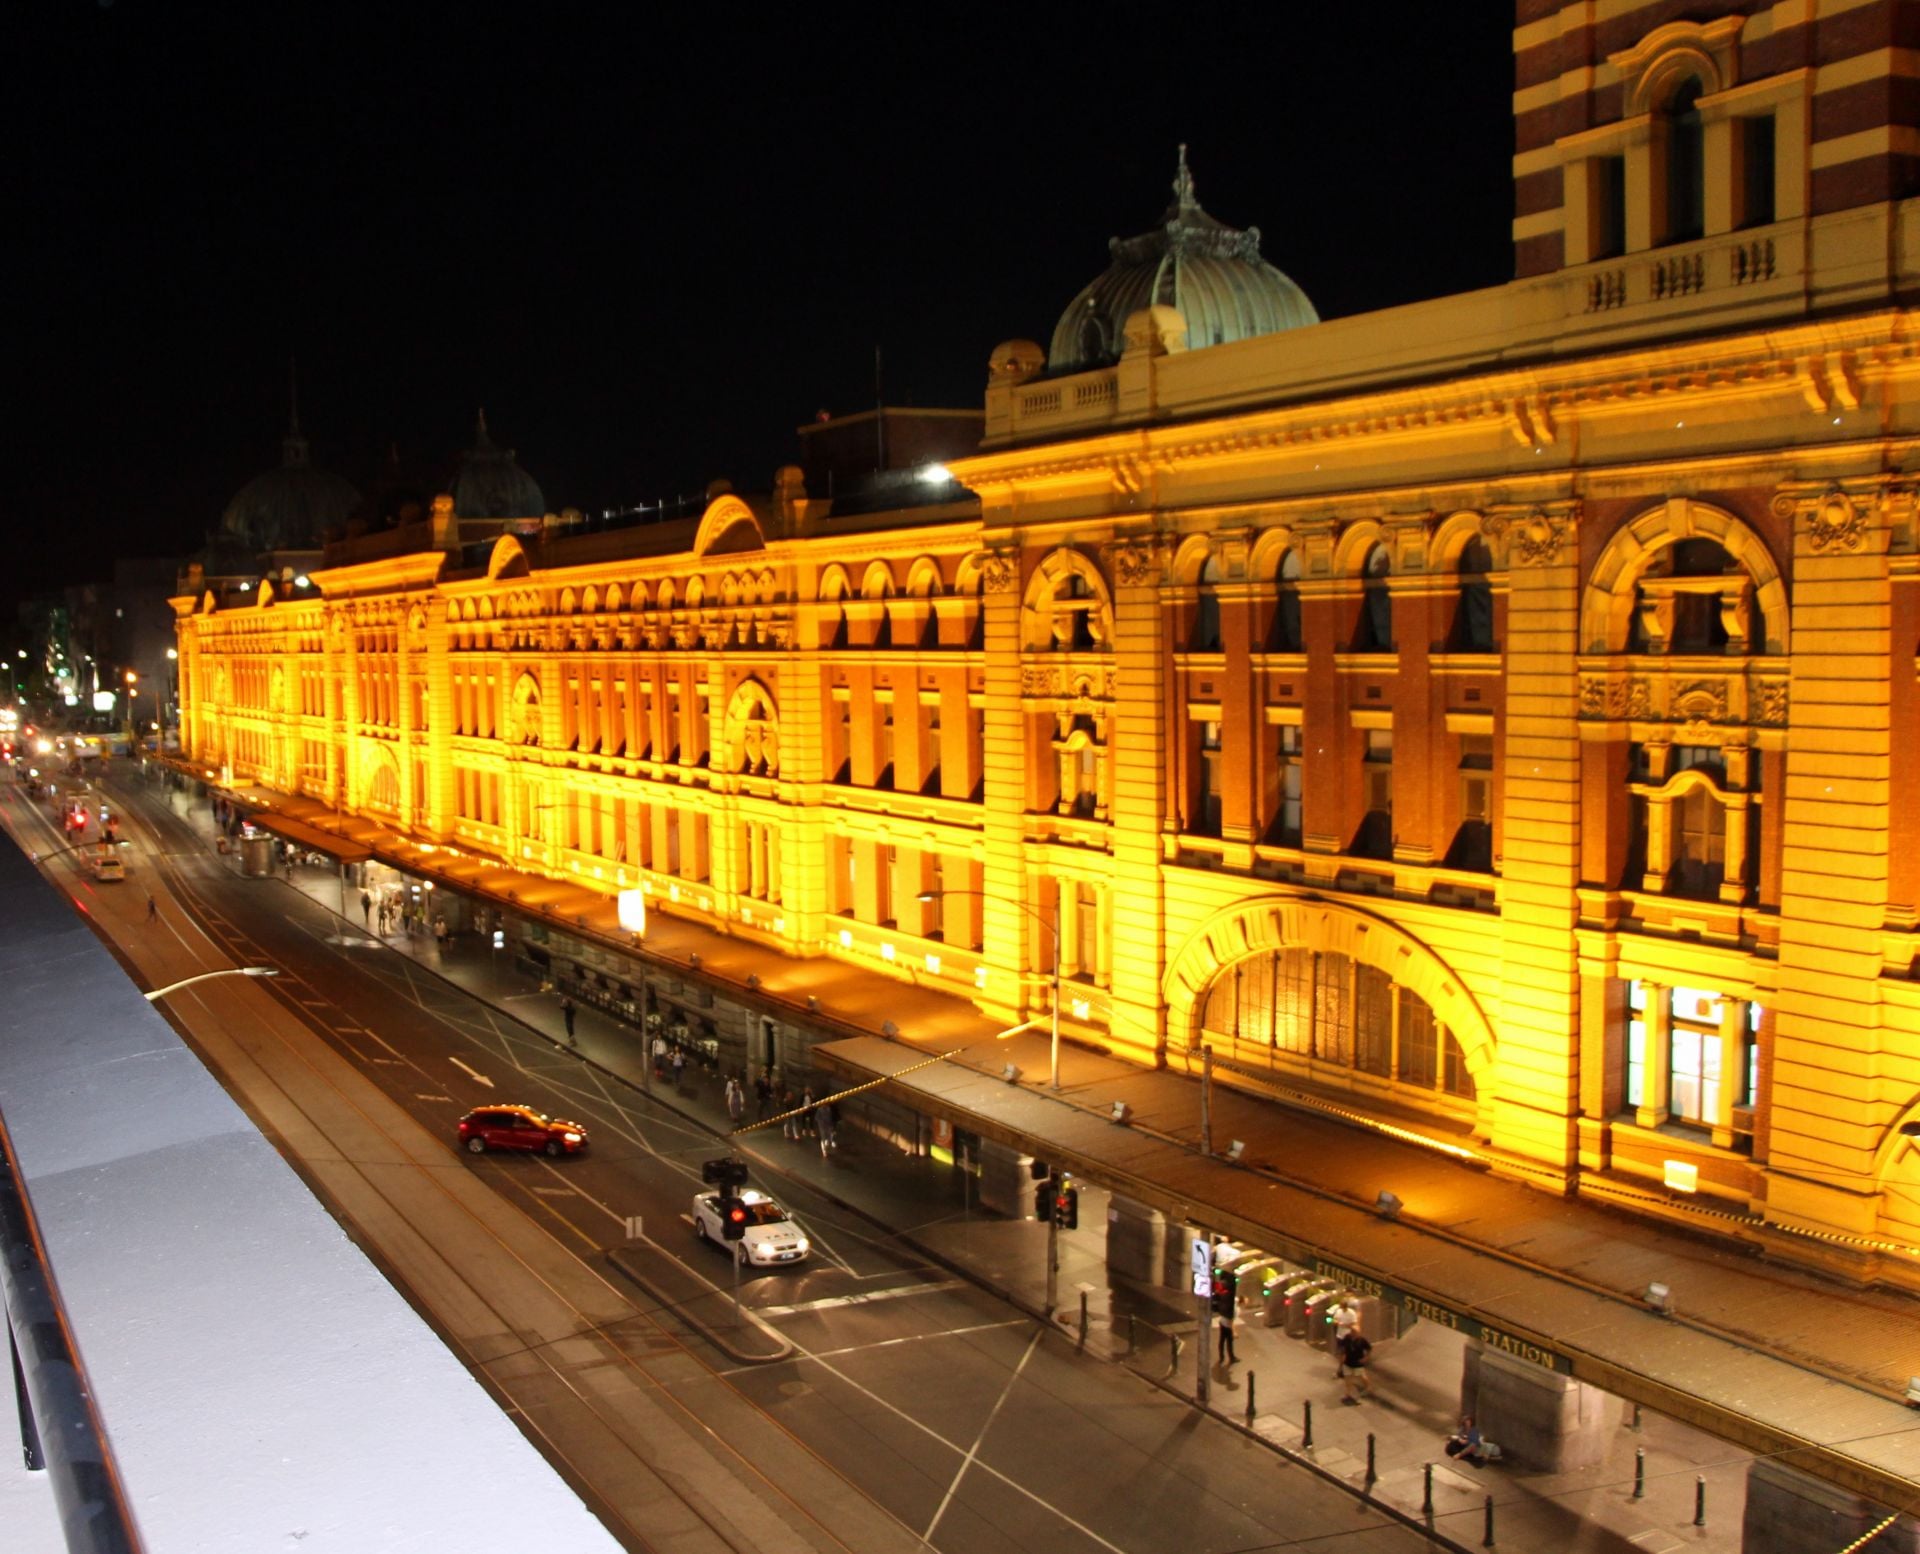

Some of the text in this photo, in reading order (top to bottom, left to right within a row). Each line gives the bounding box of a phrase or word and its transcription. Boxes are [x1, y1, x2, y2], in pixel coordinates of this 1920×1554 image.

[1316, 1261, 1553, 1369] FLINDERS STREET STATION
